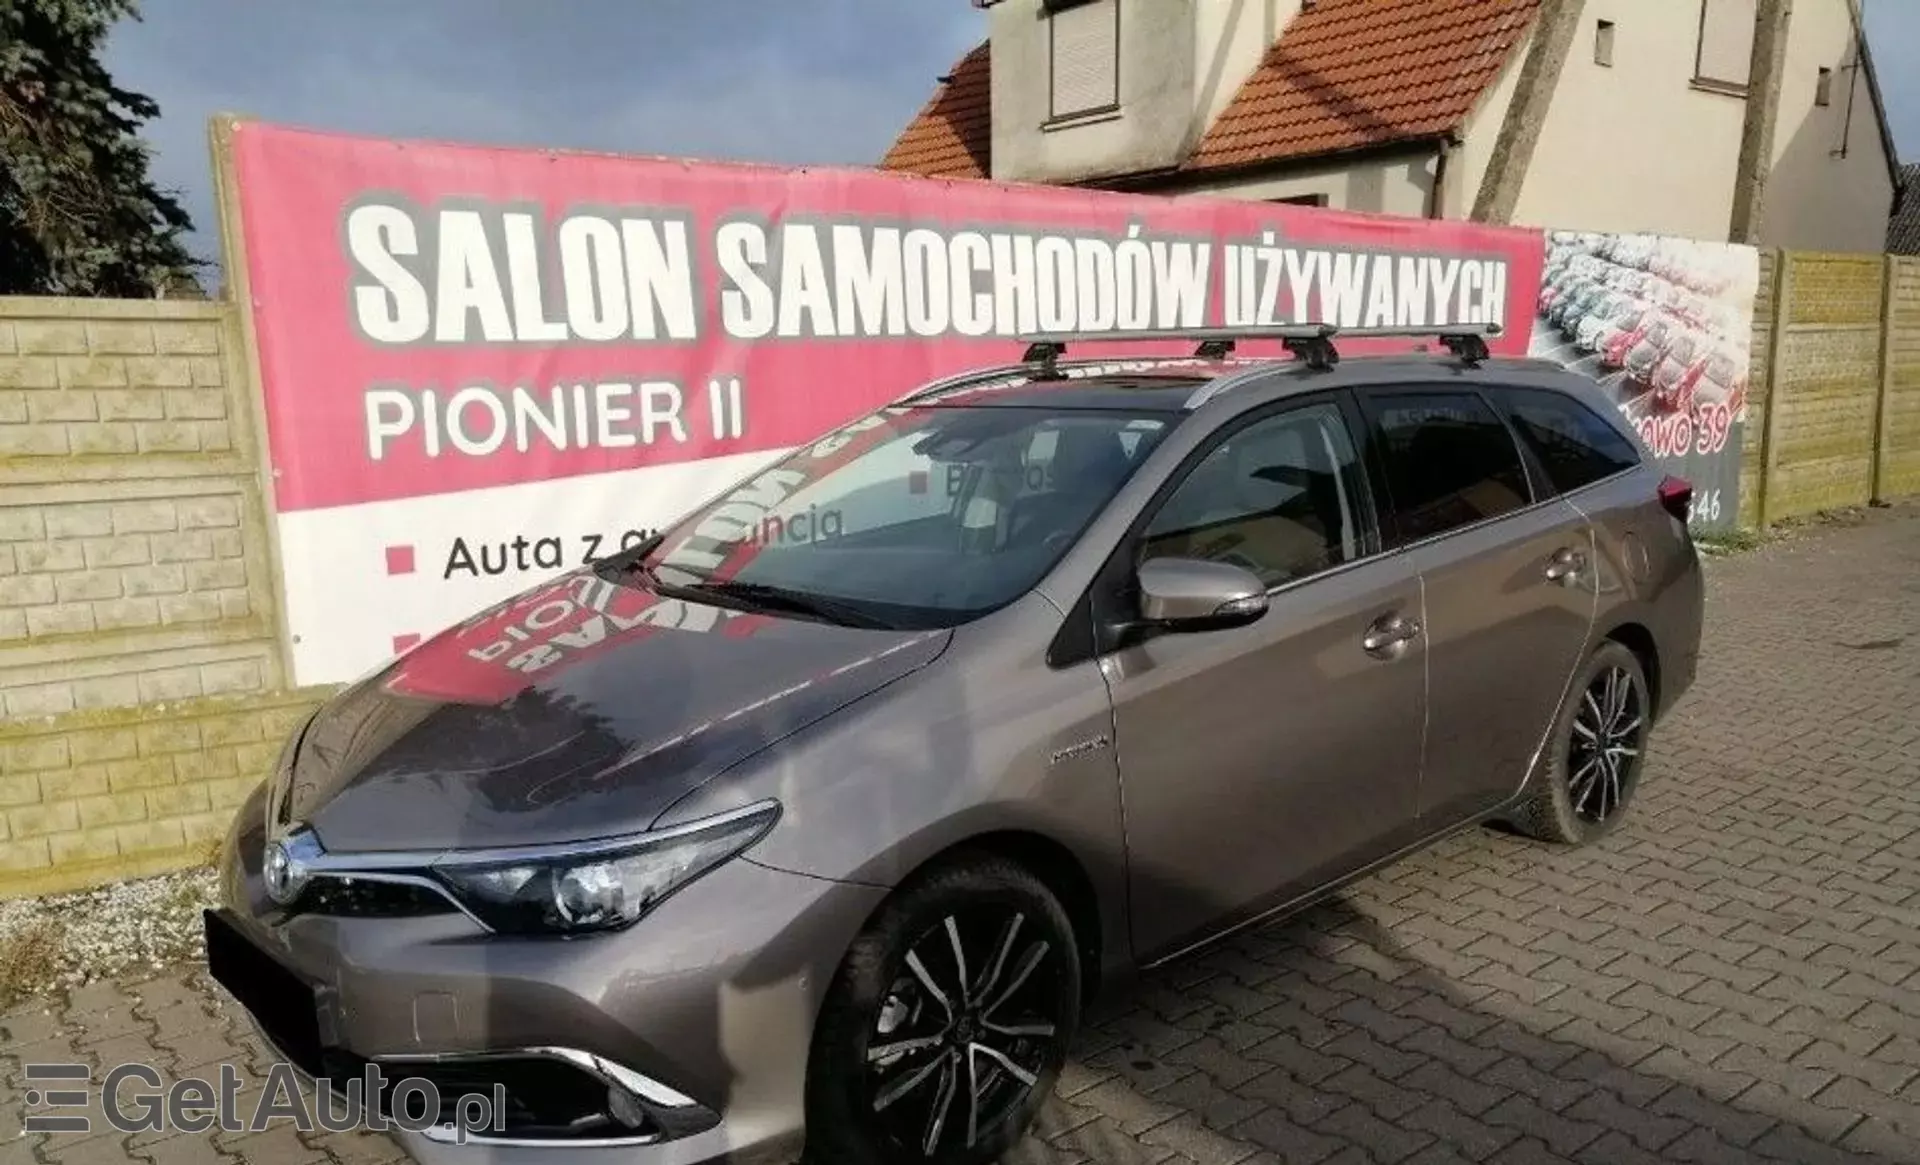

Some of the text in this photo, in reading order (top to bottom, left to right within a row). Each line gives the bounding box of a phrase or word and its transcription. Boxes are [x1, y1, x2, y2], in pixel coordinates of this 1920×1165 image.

[348, 205, 1506, 341] SALON SAMOCHODÓW UŻYWANYCH
[365, 379, 742, 460] PIONIER II
[1697, 402, 1731, 455] 39
[444, 535, 563, 579] Auta
[581, 534, 603, 564] z
